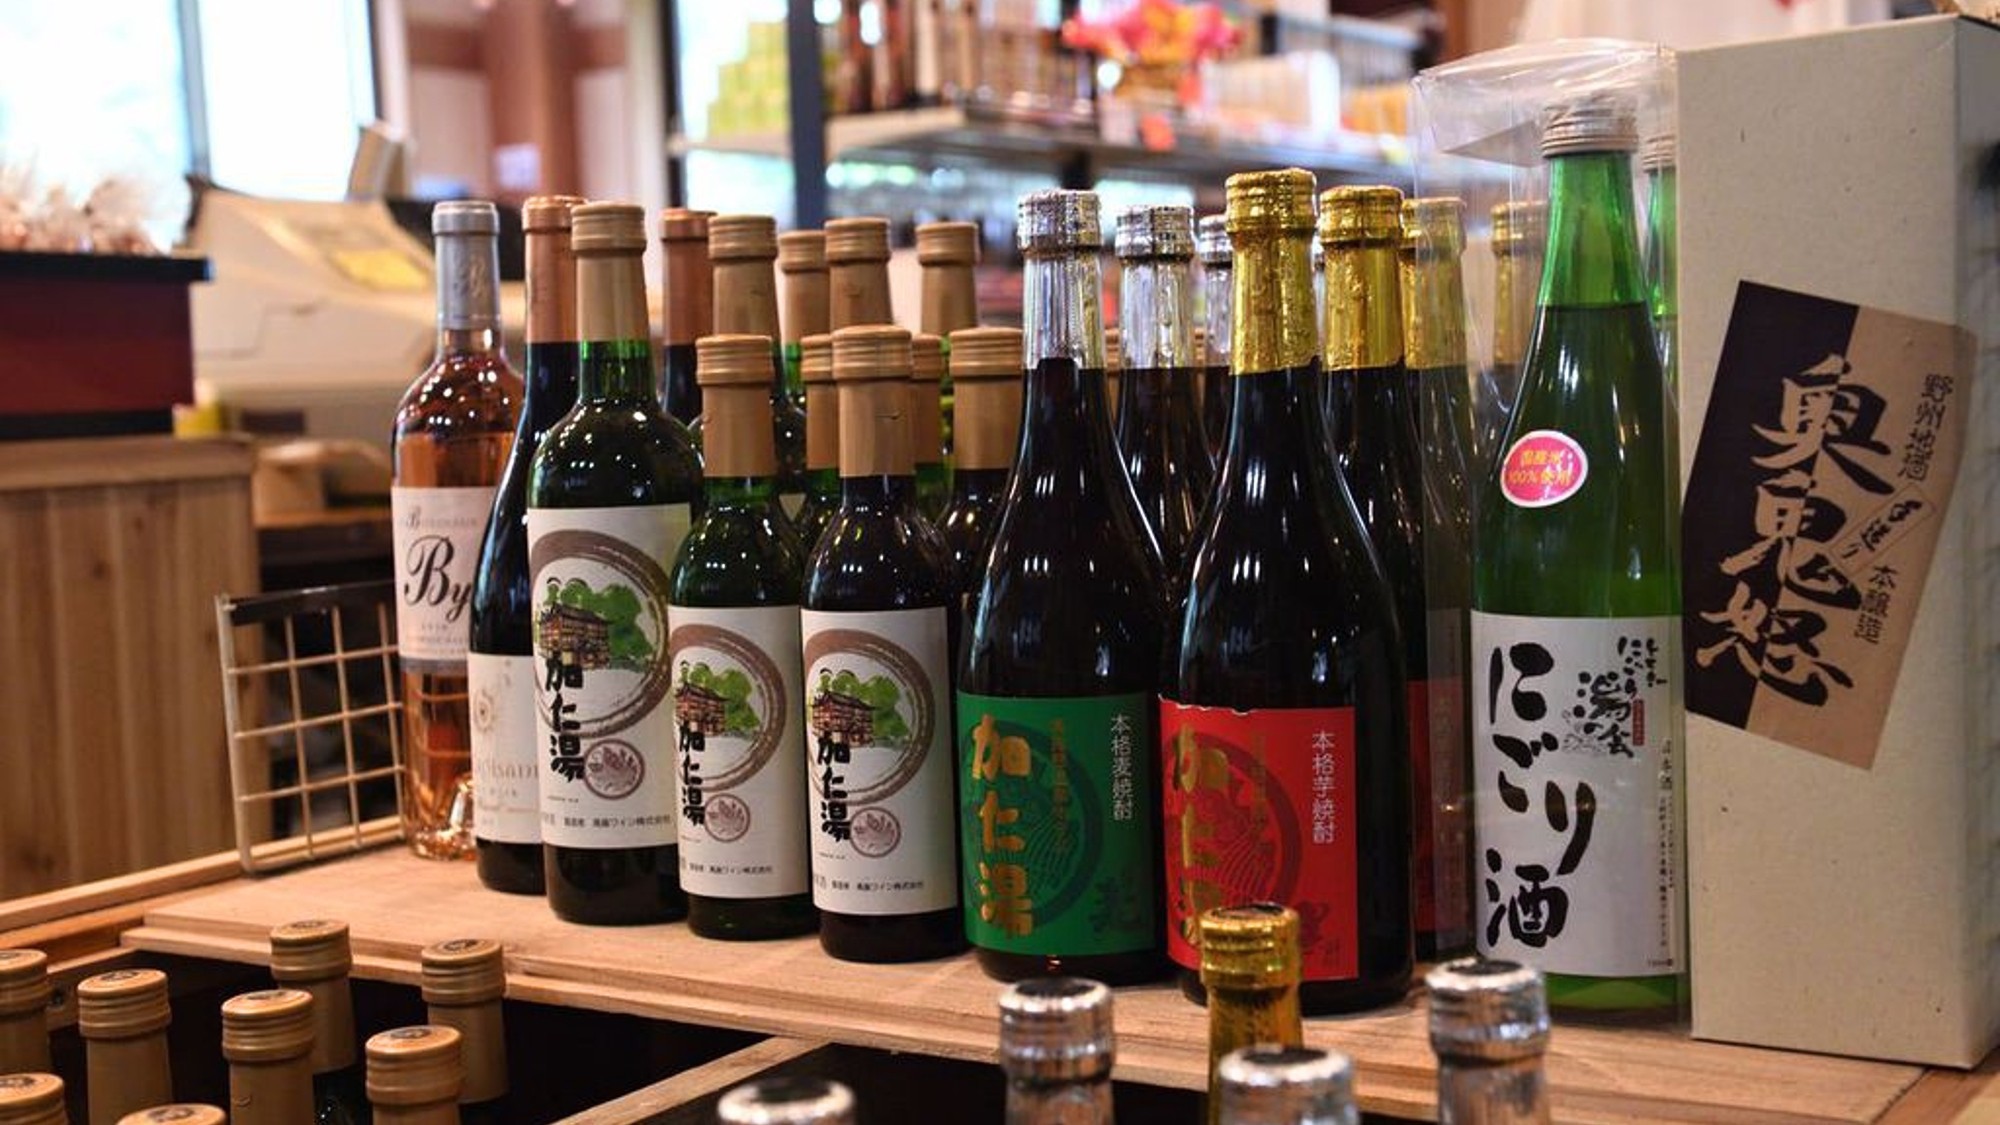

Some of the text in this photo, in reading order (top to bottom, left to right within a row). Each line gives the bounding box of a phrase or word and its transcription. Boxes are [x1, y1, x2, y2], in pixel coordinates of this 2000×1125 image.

[1696, 353, 1895, 707] 奥鬼怒
[972, 714, 1033, 940] 加仁湯
[1110, 713, 1133, 821] 本格麦焼酎
[1312, 730, 1336, 844] 本格芋焼酎
[1485, 641, 1597, 947] にごり酒
